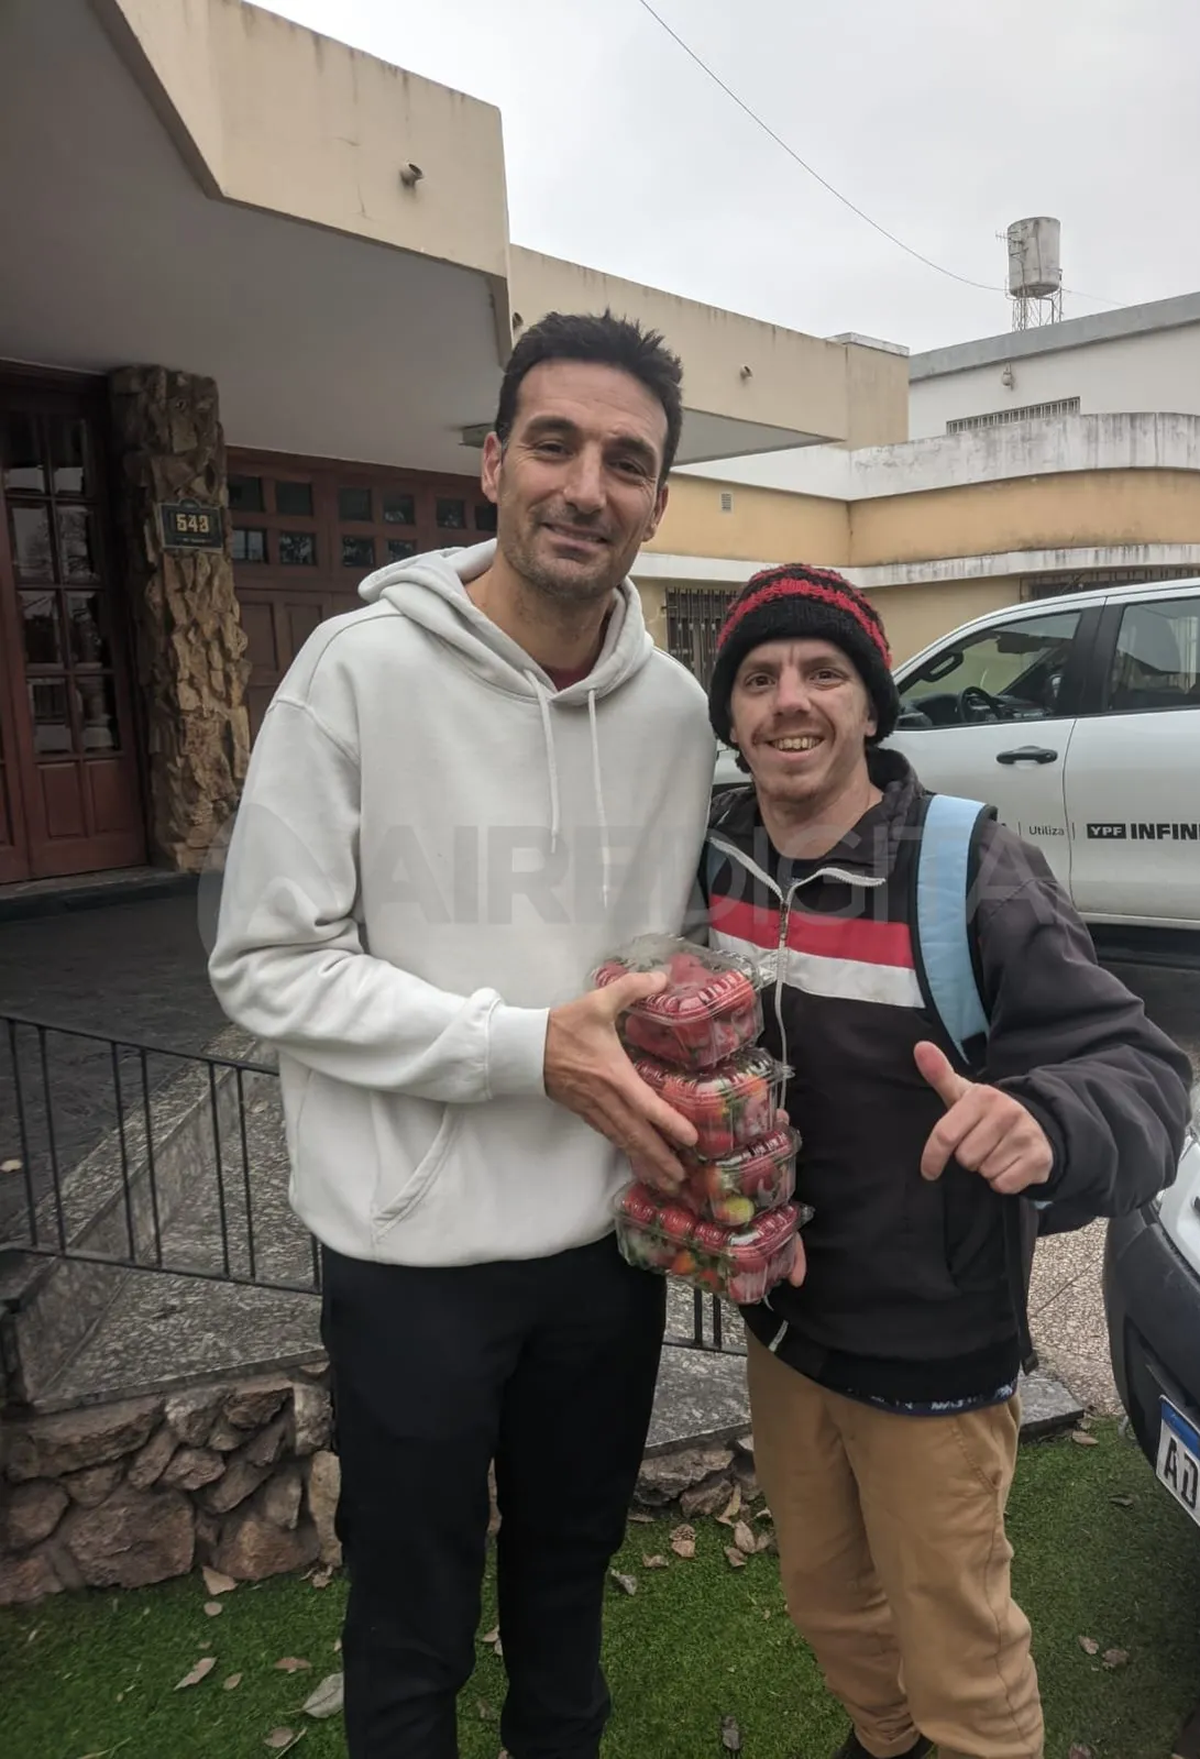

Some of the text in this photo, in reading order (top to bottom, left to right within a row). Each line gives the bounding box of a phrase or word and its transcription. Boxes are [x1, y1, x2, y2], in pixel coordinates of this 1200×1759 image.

[1028, 823, 1200, 840] Utiliza YPF INFIN
[1163, 1436, 1199, 1510] AD
